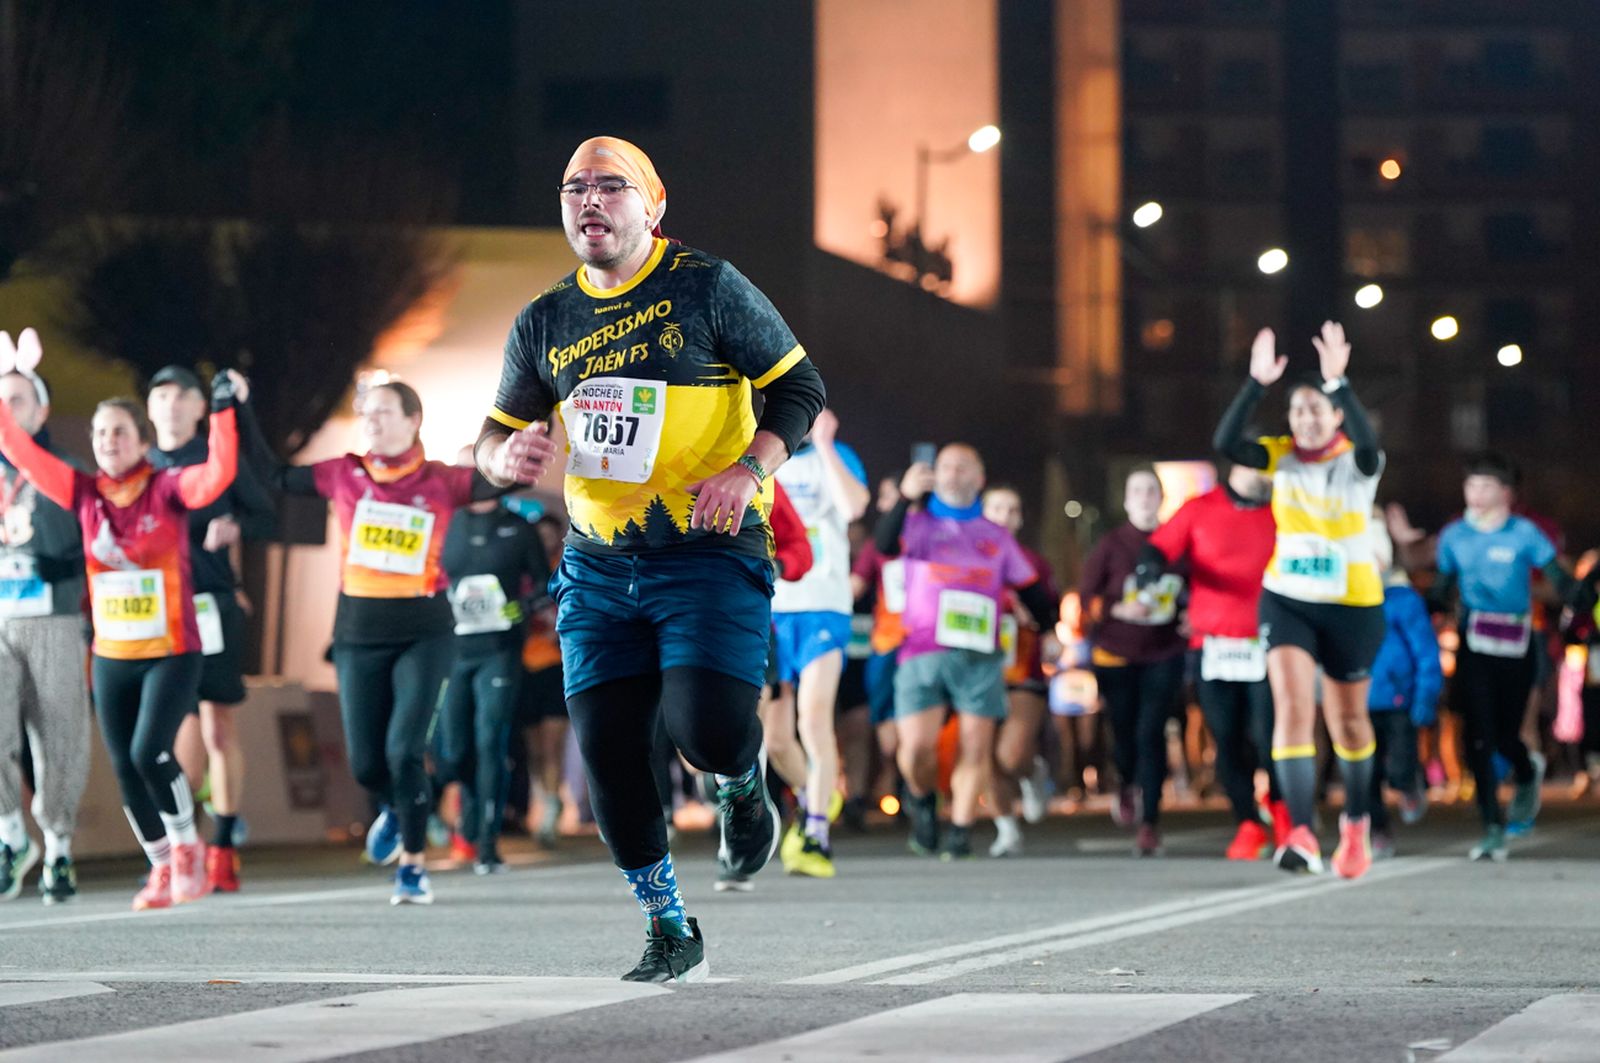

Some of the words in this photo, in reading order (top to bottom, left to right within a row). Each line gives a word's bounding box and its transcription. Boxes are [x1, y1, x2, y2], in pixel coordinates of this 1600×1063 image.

[548, 299, 672, 378] SENDERISMO
[578, 349, 627, 380] JAÉN
[629, 342, 649, 361] FS
[573, 399, 591, 411] SAN
[582, 387, 611, 399] NOCHE
[612, 389, 624, 400] DE
[582, 412, 639, 446] 7657
